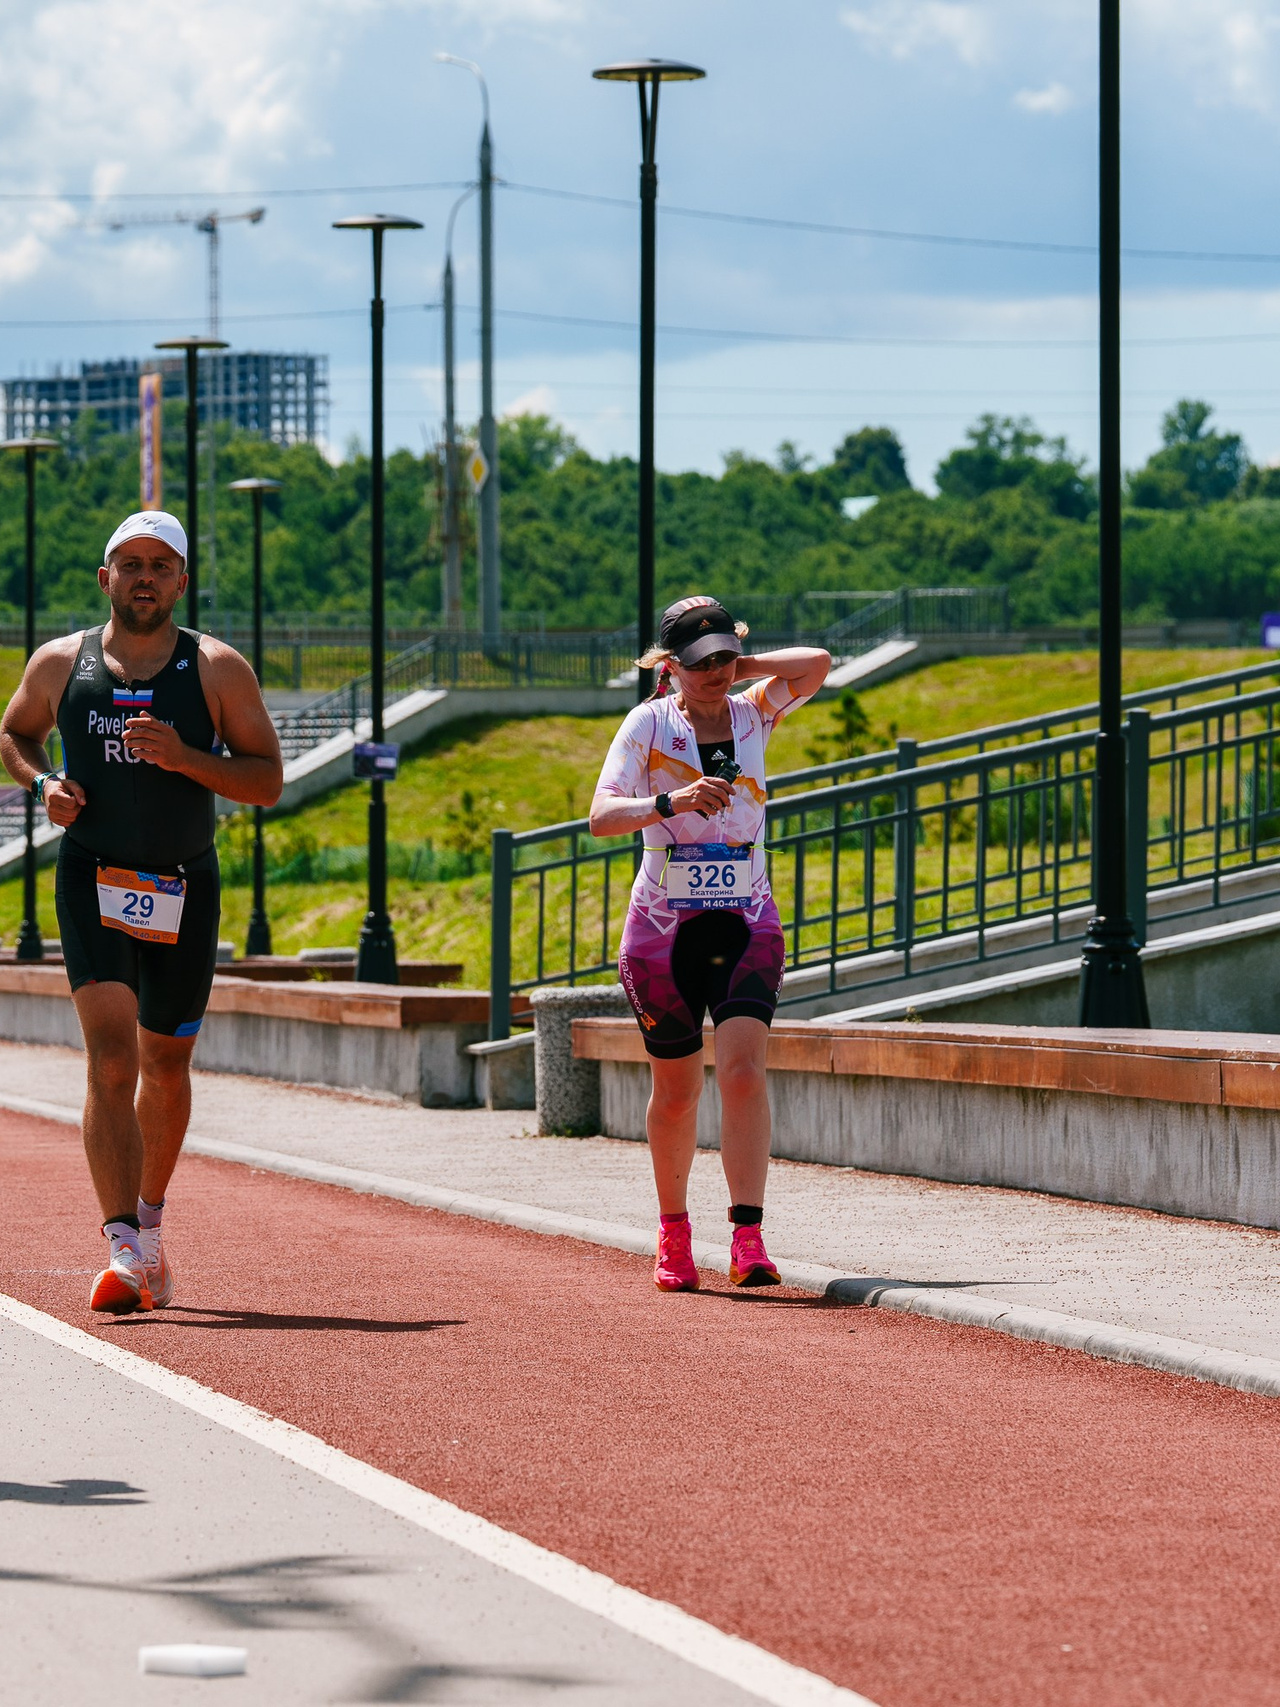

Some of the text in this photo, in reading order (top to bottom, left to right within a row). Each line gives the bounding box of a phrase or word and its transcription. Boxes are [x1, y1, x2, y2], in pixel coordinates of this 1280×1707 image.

[88, 710, 125, 735] Pavel
[104, 739, 157, 765] RU
[687, 864, 736, 889] 326
[121, 892, 155, 918] 29
[690, 889, 734, 897] Екатерина
[712, 899, 738, 907] 40-44
[124, 915, 150, 926] Павел
[621, 942, 643, 1014] AstraZeneca
